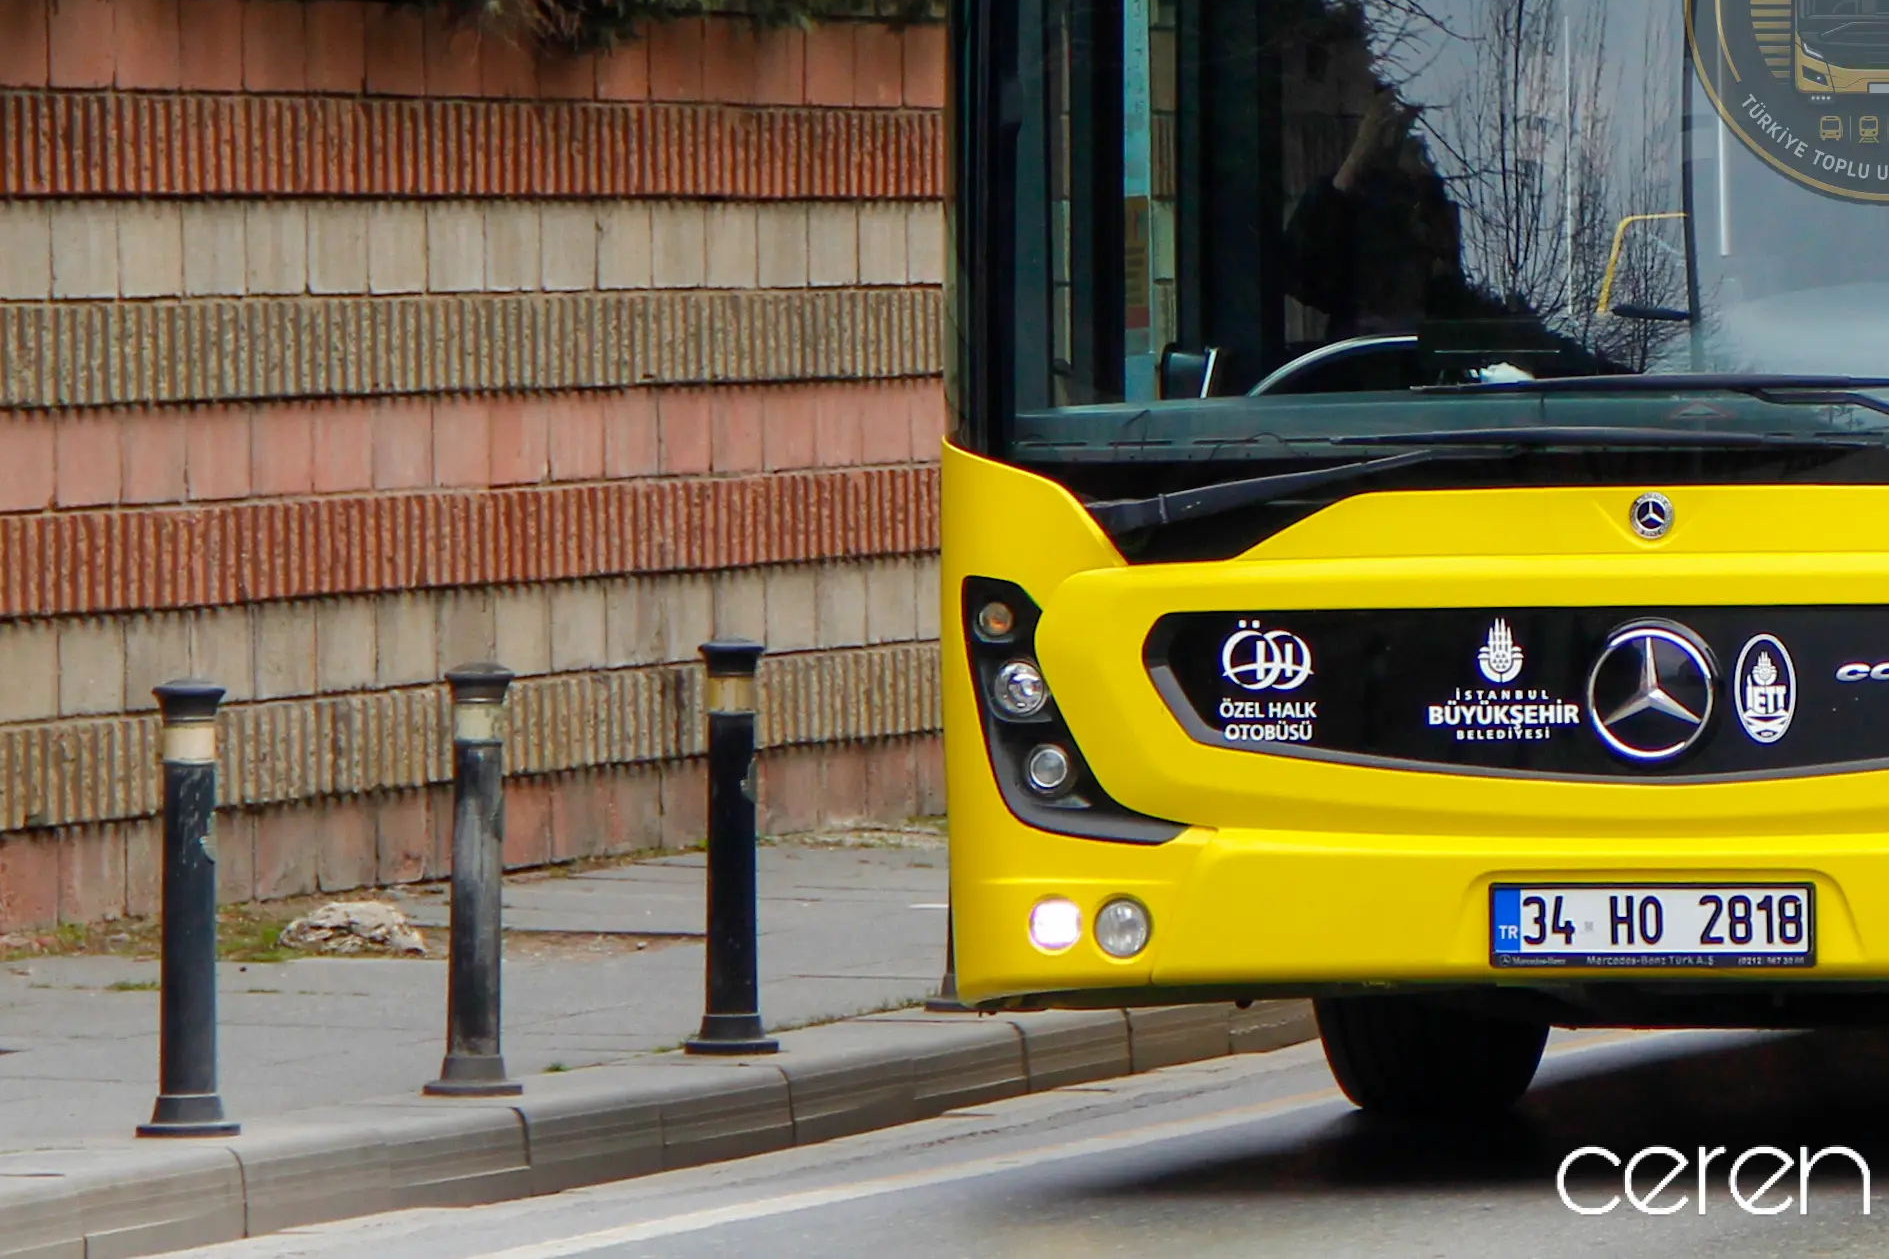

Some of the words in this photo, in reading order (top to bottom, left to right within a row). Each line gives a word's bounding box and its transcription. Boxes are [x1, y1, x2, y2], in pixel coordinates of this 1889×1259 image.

[1456, 687, 1550, 701] İSTANBUL
[1219, 699, 1265, 719] ÖZEL
[1269, 702, 1317, 719] HALK
[1428, 699, 1580, 730] BÜYÜKŞEHİR
[1224, 722, 1313, 741] OTOBÜSÜ
[1456, 726, 1551, 740] BELEDİYESİ
[1523, 895, 1576, 945] 34
[1698, 894, 1804, 945] 2818
[1499, 924, 1519, 940] TR
